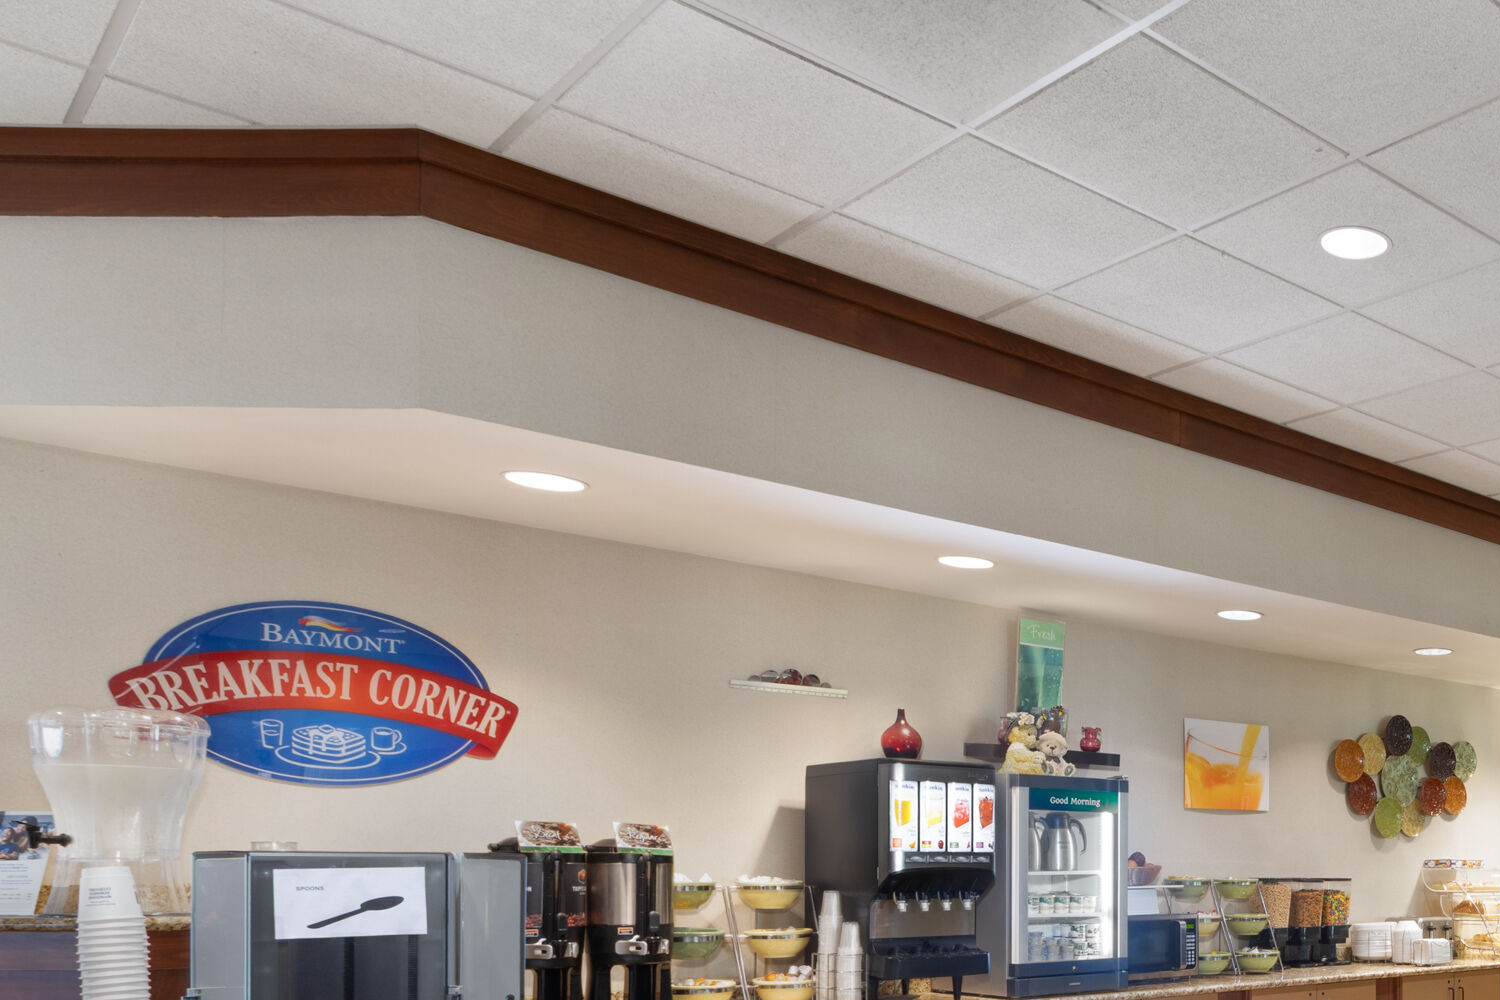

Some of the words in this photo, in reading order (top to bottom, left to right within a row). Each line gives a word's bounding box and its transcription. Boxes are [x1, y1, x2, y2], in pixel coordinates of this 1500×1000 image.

[260, 622, 400, 654] BAYMONT
[1026, 624, 1057, 640] Fresh
[125, 659, 358, 711] BREAKFAST
[369, 669, 506, 738] CORNER
[1050, 796, 1069, 805] Good
[1070, 797, 1101, 808] Morning
